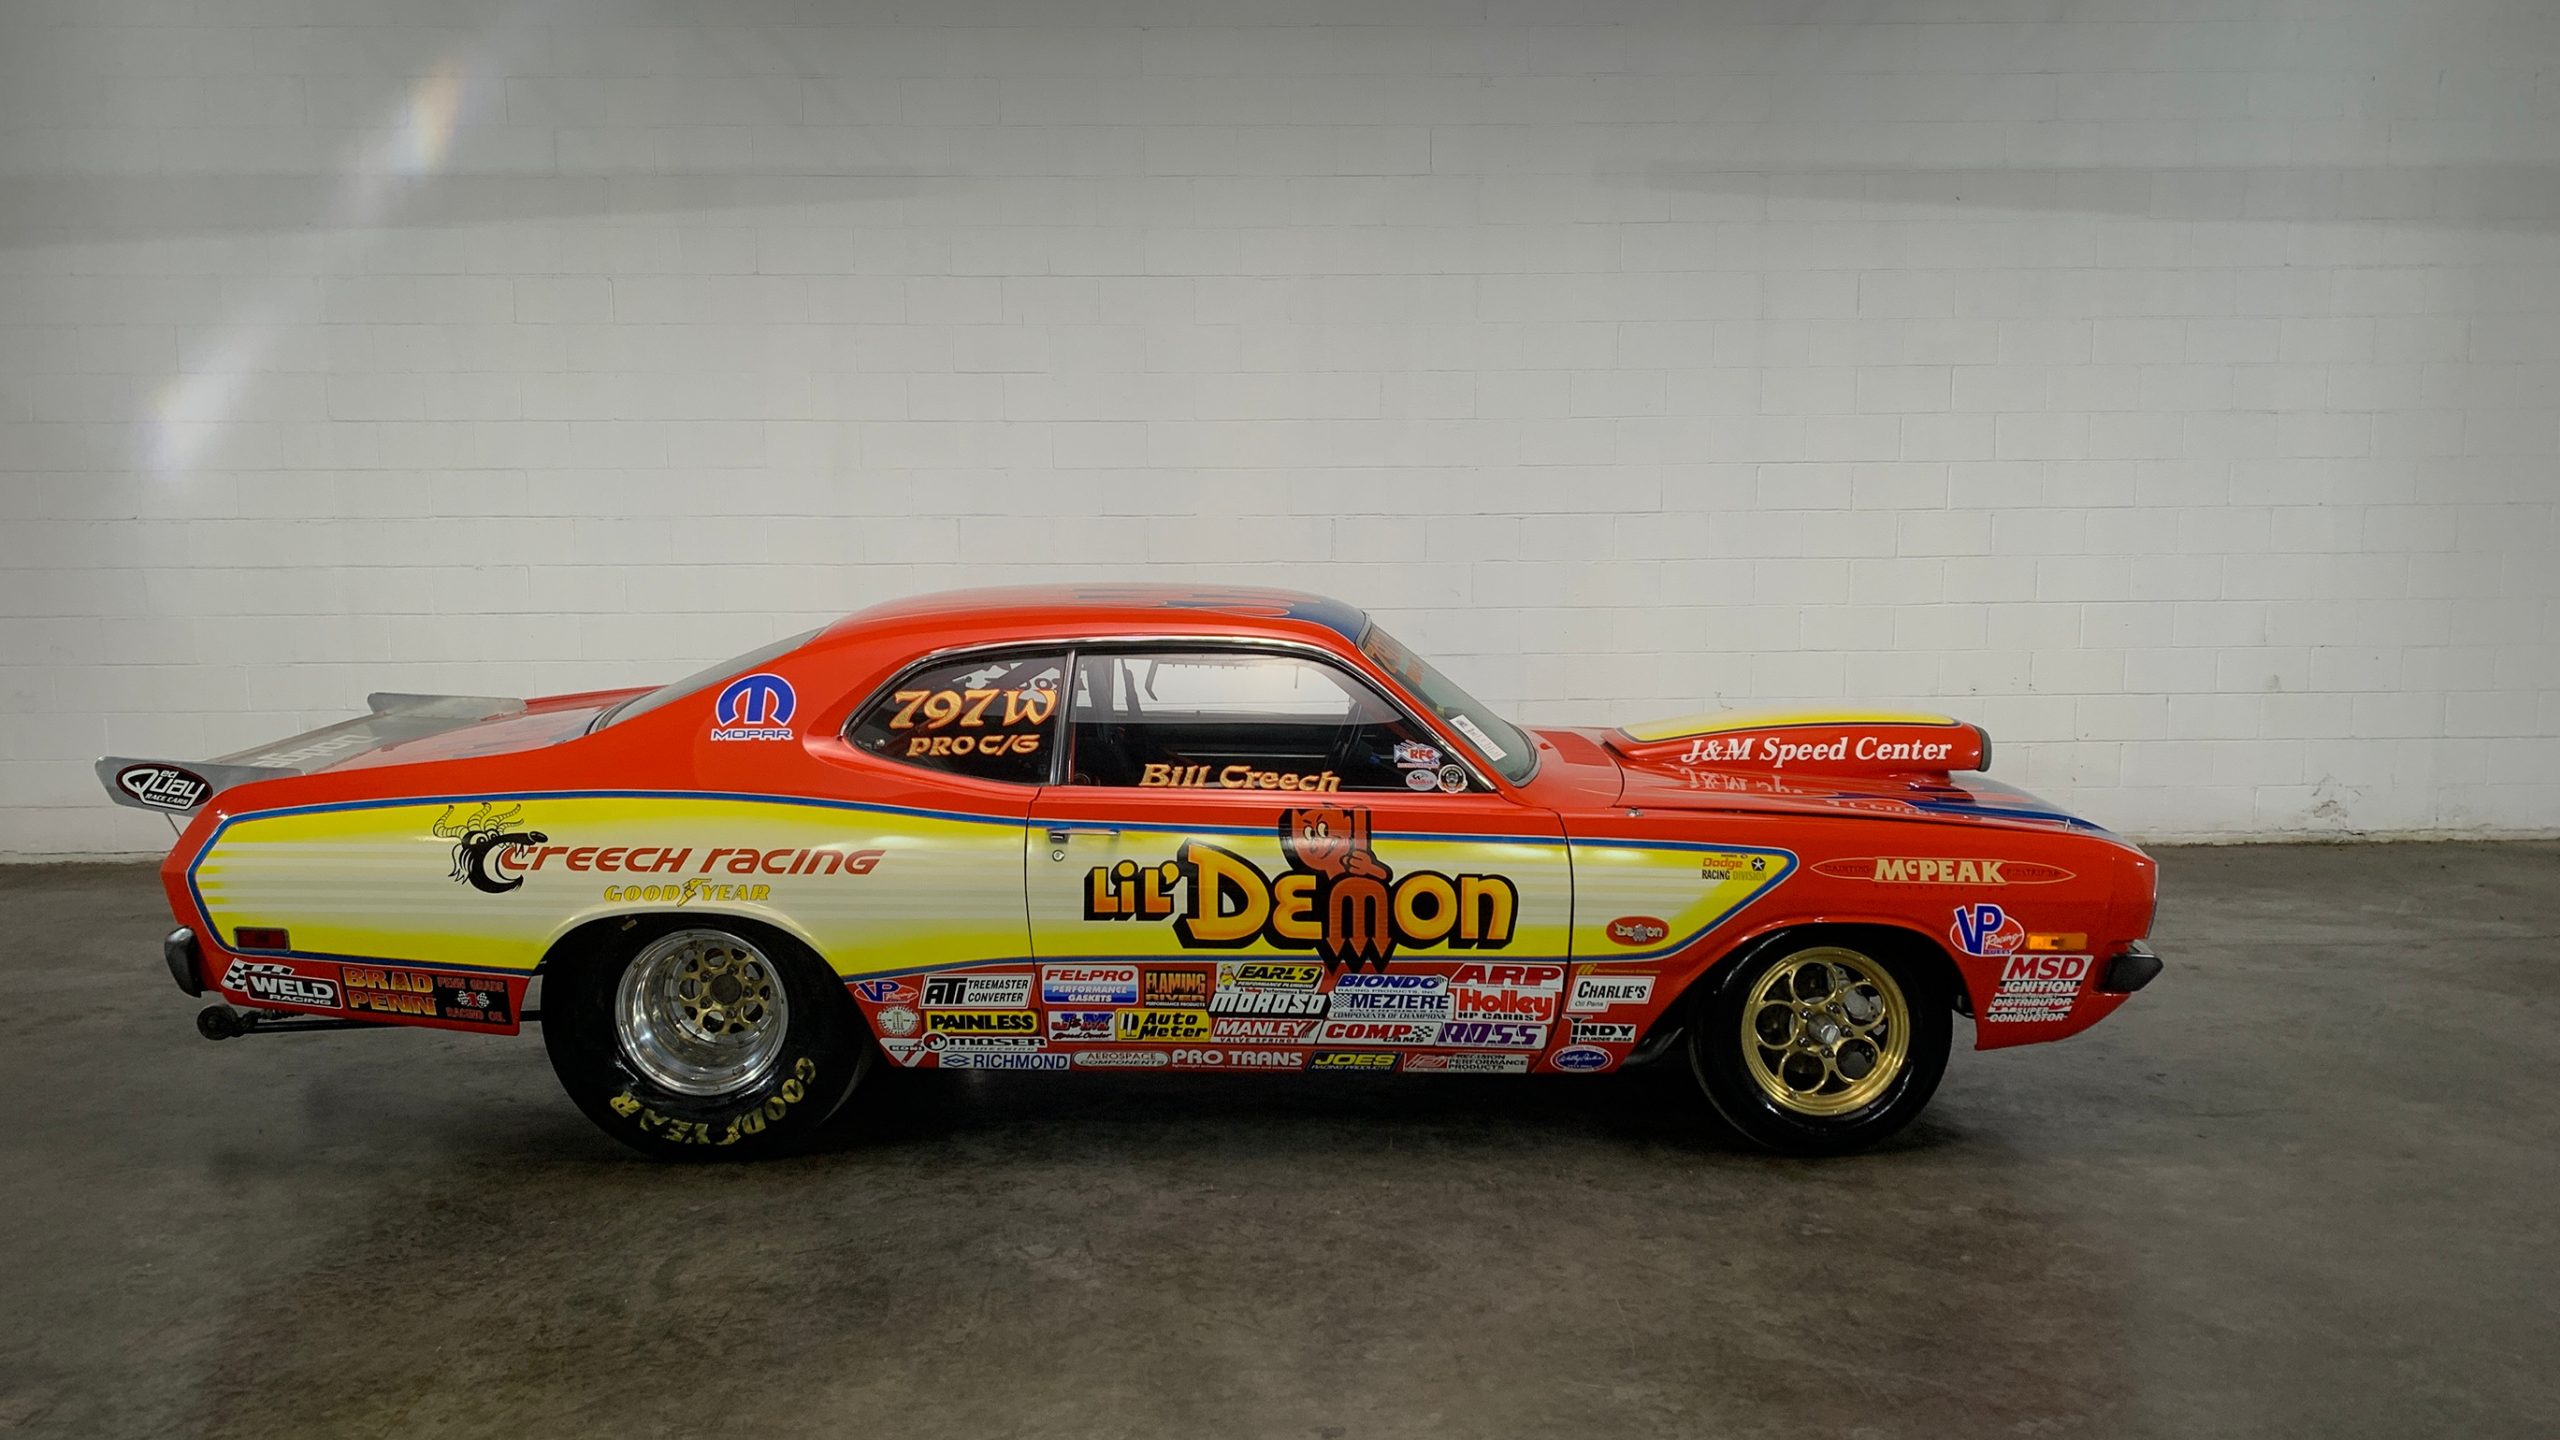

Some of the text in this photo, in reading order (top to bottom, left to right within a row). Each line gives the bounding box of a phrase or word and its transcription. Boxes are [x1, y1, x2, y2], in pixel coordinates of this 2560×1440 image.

[889, 689, 1057, 729] 797 W
[711, 728, 794, 741] MOPAR
[906, 734, 1041, 757] PRO C/G
[1681, 736, 1953, 768] J&M Speed Center
[1139, 764, 1342, 792] Bill Creech
[144, 792, 189, 805] RACE CARS
[1703, 857, 1743, 871] Dodge
[1701, 869, 1767, 881] RACING DIVISION
[1953, 903, 2005, 956] VP
[1045, 970, 1135, 982] FEL-PRO
[1239, 966, 1317, 981] EARL'S
[1451, 966, 1562, 986] ARP
[2006, 957, 2085, 980] MSD
[250, 976, 335, 999] WELD
[344, 967, 434, 993] BRAD
[968, 979, 1029, 990] TREEMASTER
[1145, 972, 1206, 994] FLAMING
[1337, 975, 1440, 989] BIONDO
[2002, 981, 2077, 993] IGNITION
[858, 981, 900, 1003] VP
[924, 978, 968, 1005] ATI
[1051, 985, 1128, 994] PERFORMANCE
[1578, 981, 1647, 999] CHARLIE'S
[269, 994, 332, 1006] RACING
[348, 990, 438, 1016] PENN
[967, 992, 1024, 1003] CONVERTER
[1068, 994, 1113, 1003] GASKETS
[1209, 993, 1327, 1014] MOROSO
[1351, 994, 1450, 1009] MEZIERE
[1459, 988, 1553, 1020] Holley
[1993, 998, 2073, 1007] DISTRIBUTOR
[929, 1014, 1035, 1031] PAINLESS
[1143, 1013, 1198, 1025] Auto
[1458, 1012, 1535, 1021] HP CARBS
[1988, 1013, 2066, 1023] CONDUCTOR
[1139, 1026, 1208, 1040] Meter
[1217, 1020, 1307, 1036] MANLEY
[1325, 1023, 1413, 1039] COMP
[1438, 1023, 1545, 1045] ROSS
[1564, 1014, 1635, 1045] INDY
[973, 1054, 1068, 1069] RICHMOND
[1086, 1051, 1157, 1060] AEROSPACE
[1172, 1050, 1303, 1066] PRO TRANS
[1314, 1054, 1396, 1066] JOES
